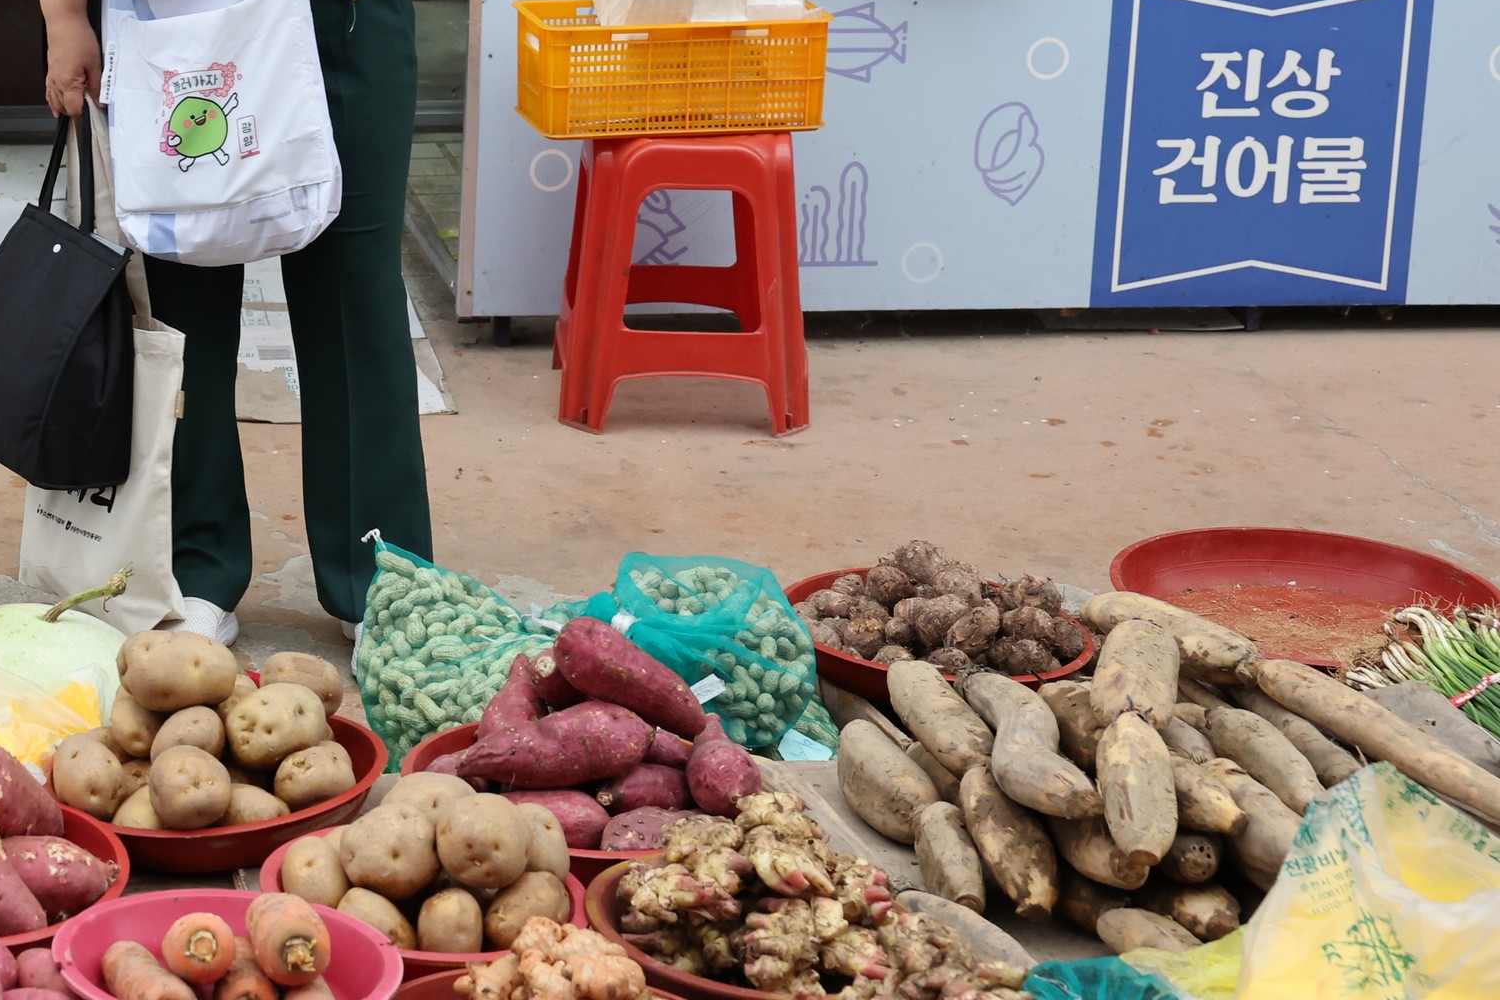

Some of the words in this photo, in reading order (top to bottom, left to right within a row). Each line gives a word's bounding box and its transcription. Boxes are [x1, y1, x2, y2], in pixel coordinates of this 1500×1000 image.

[171, 73, 220, 94] 놀러가자
[1196, 47, 1342, 120] 진상
[1151, 135, 1368, 205] 건어물
